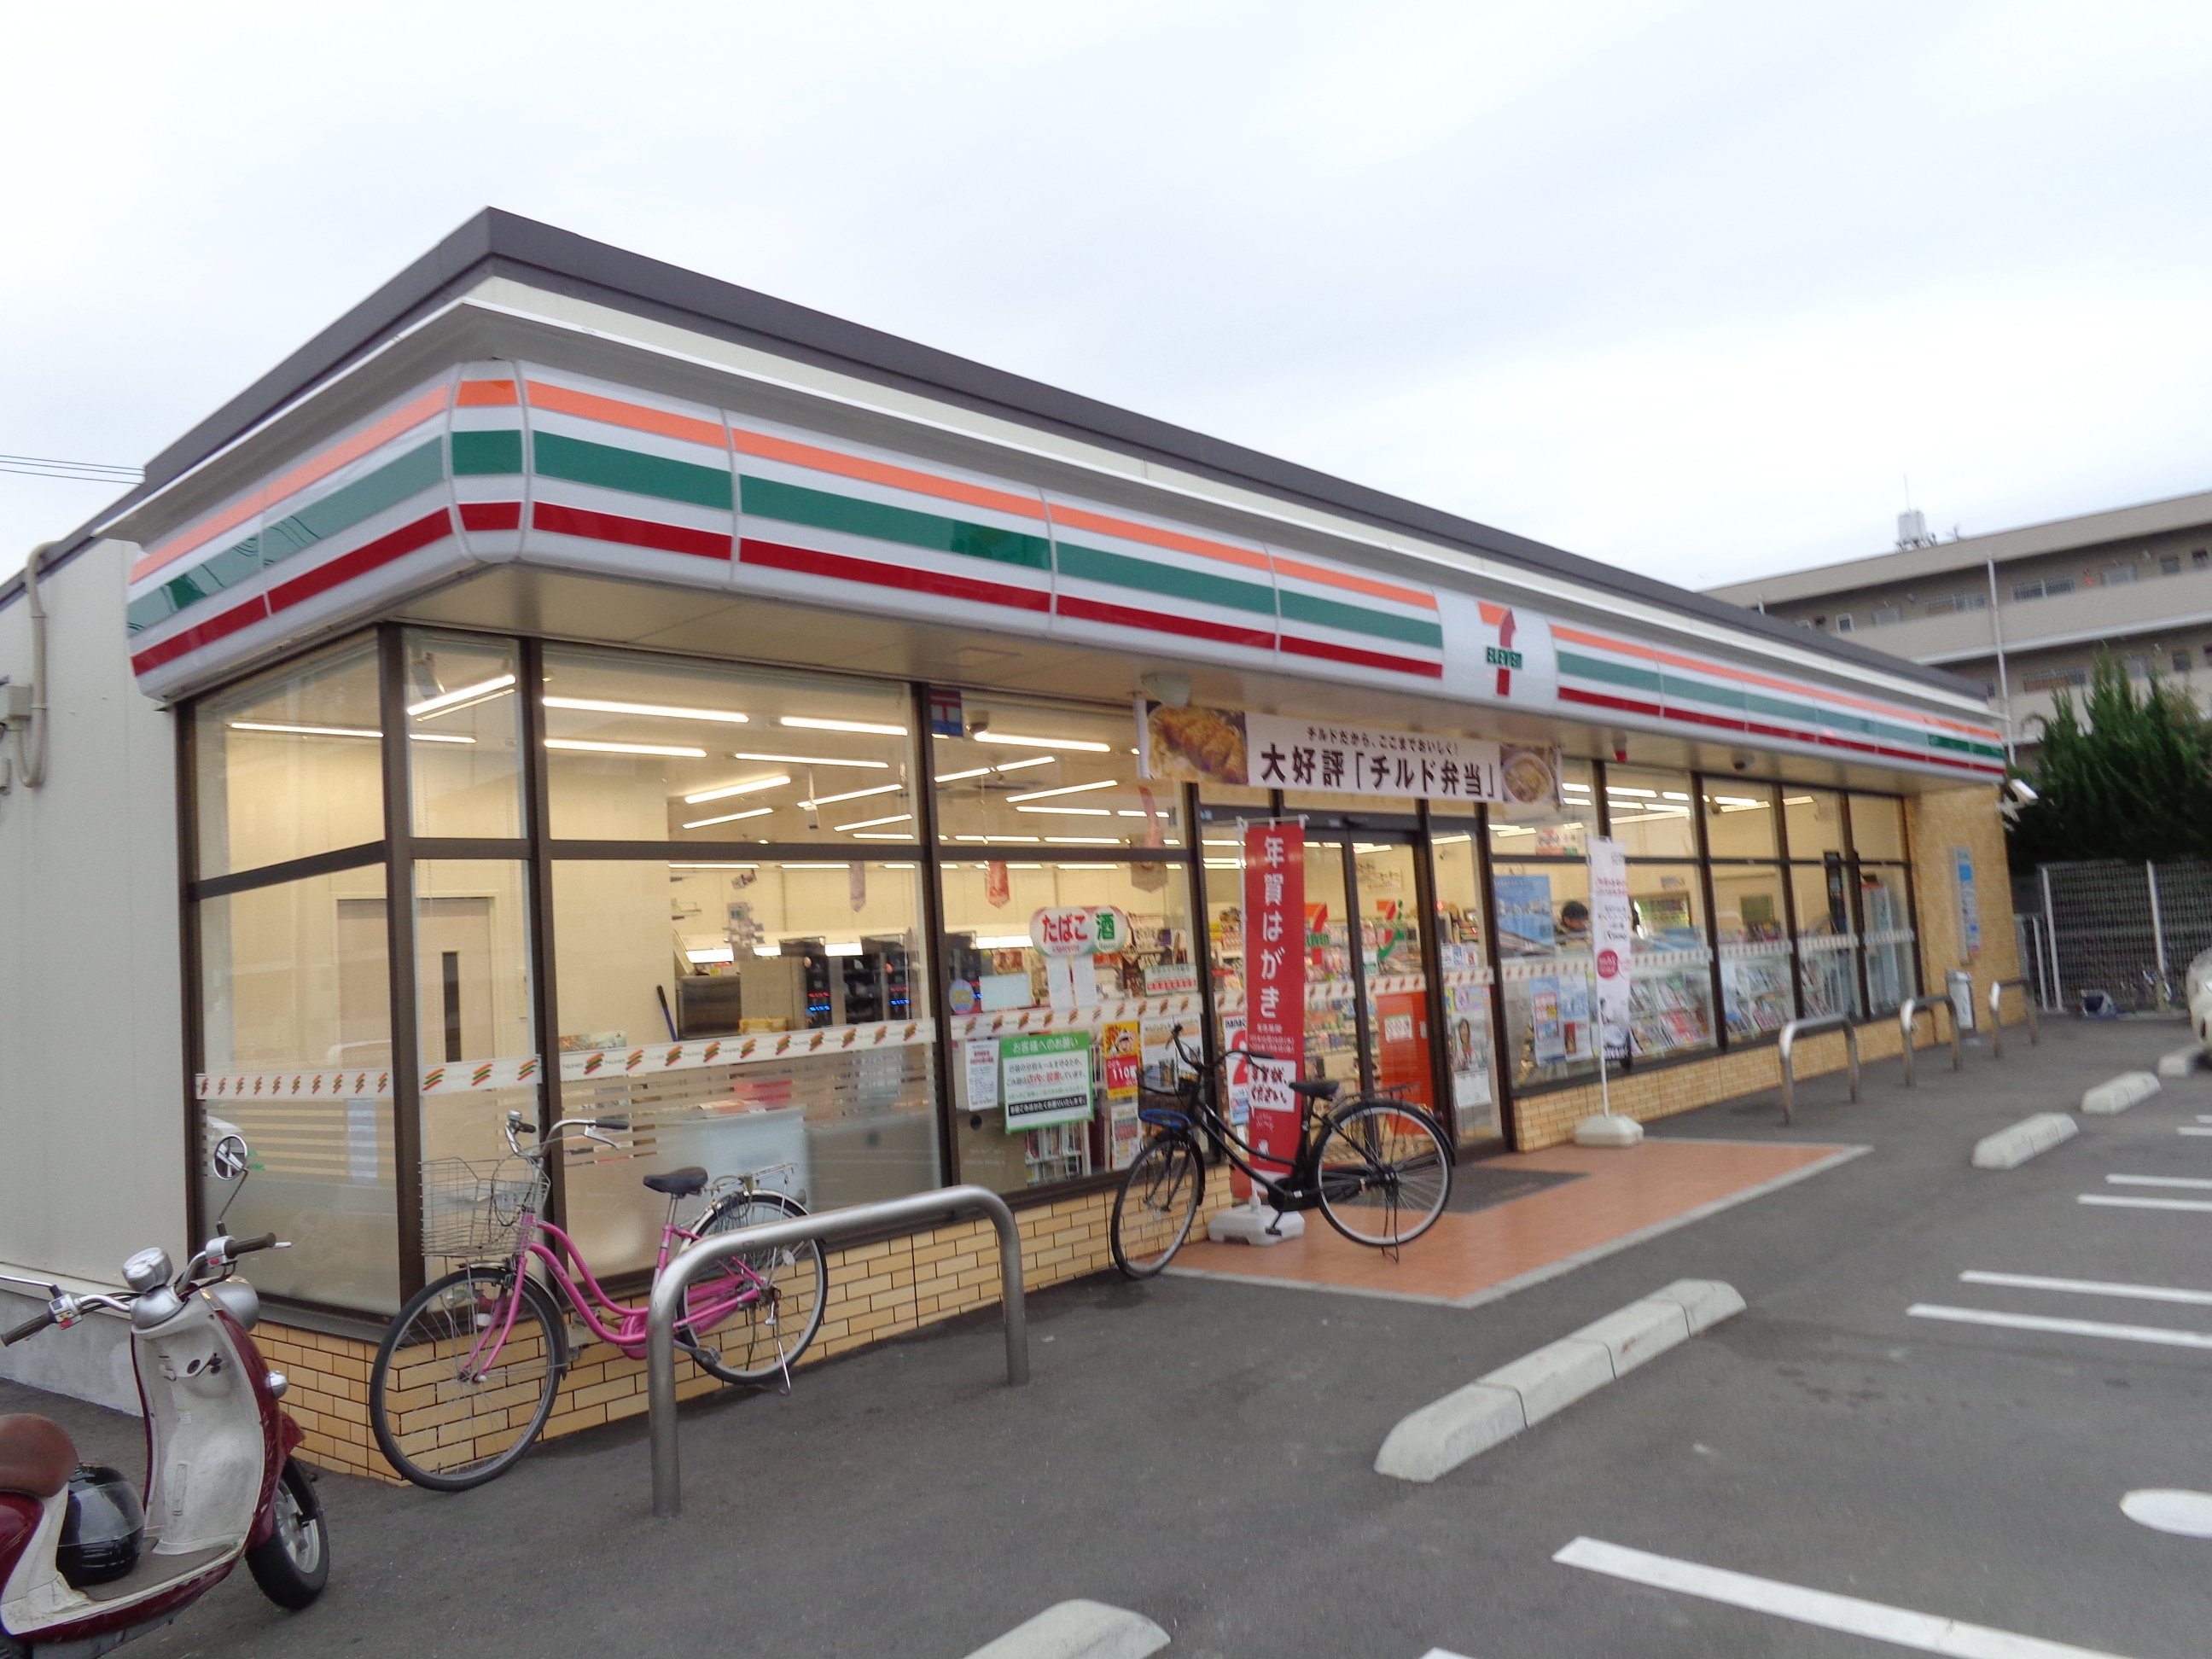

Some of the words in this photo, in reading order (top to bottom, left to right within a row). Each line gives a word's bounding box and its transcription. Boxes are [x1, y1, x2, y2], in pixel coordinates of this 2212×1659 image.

[1042, 912, 1088, 944] たばこ
[1096, 912, 1115, 941] 酒
[1260, 835, 1285, 1020] 年賀はがき
